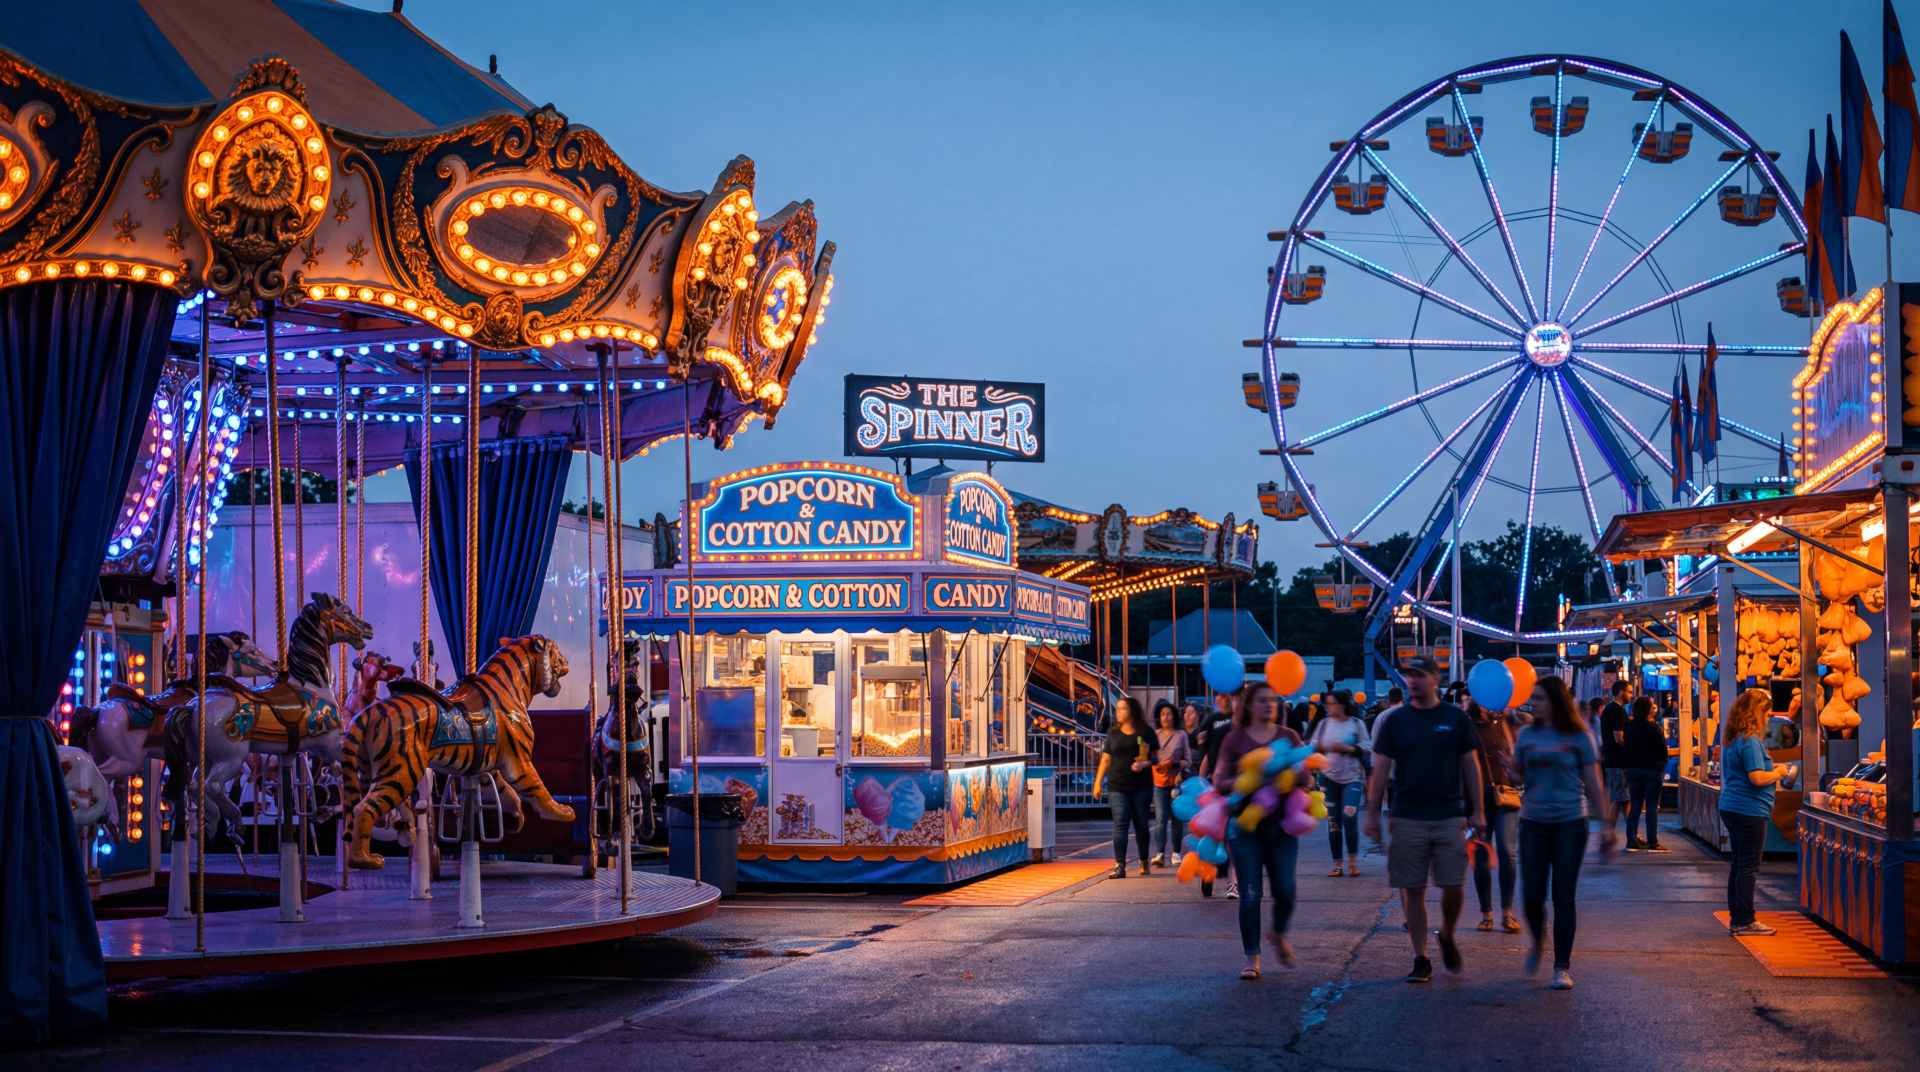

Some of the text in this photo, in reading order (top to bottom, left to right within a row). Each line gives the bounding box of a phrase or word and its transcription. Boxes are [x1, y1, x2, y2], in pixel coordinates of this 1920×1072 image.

[918, 383, 977, 408] THE
[857, 396, 1038, 456] SPINNER
[739, 477, 876, 512] POPCORN
[960, 486, 997, 527] POPCORN
[799, 503, 815, 519] &
[708, 520, 906, 547] COTTON CANDY
[950, 519, 1007, 559] COTTON CANDY
[673, 582, 902, 609] POPCORN & COTTON
[932, 582, 1008, 609] CANDY
